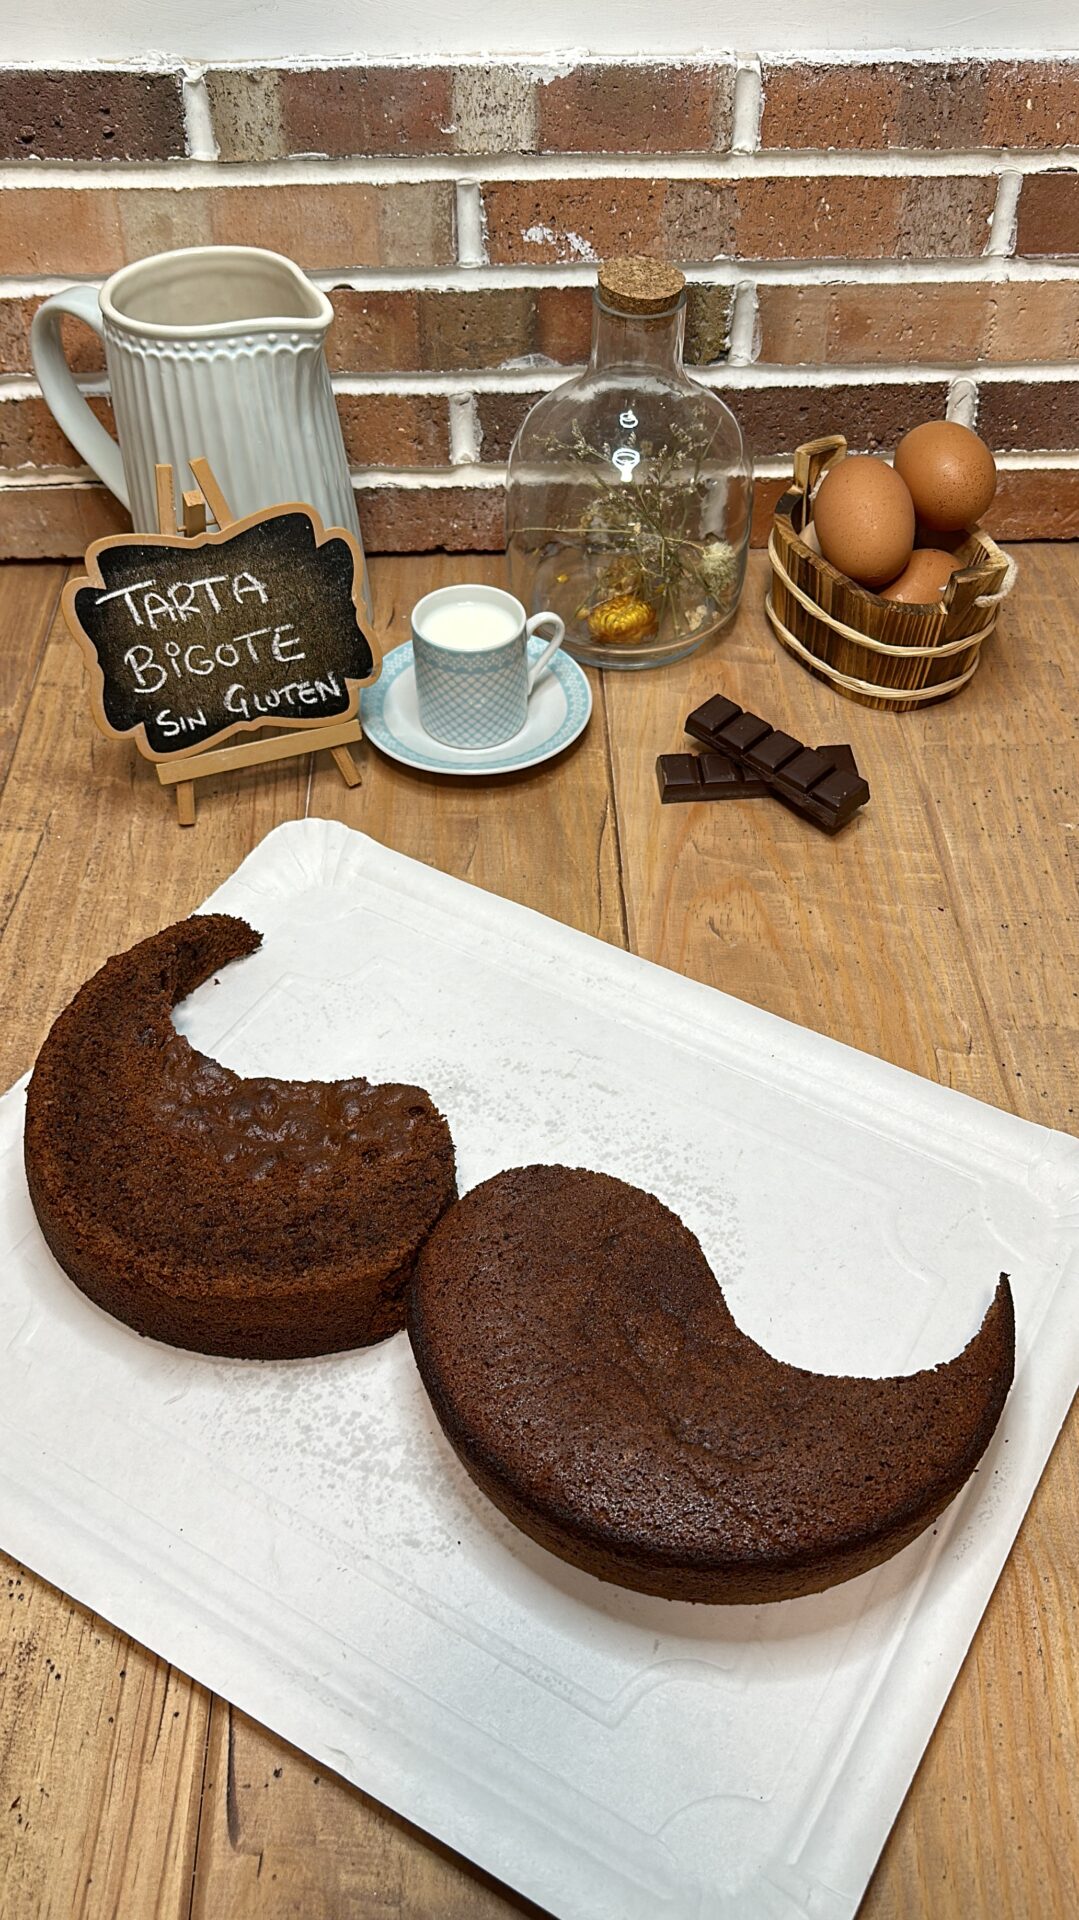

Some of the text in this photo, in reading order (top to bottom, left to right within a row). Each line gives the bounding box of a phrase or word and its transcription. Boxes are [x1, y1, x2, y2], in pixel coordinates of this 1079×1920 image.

[96, 572, 268, 629] TARTA
[155, 672, 342, 736] SIN GLUTEN
